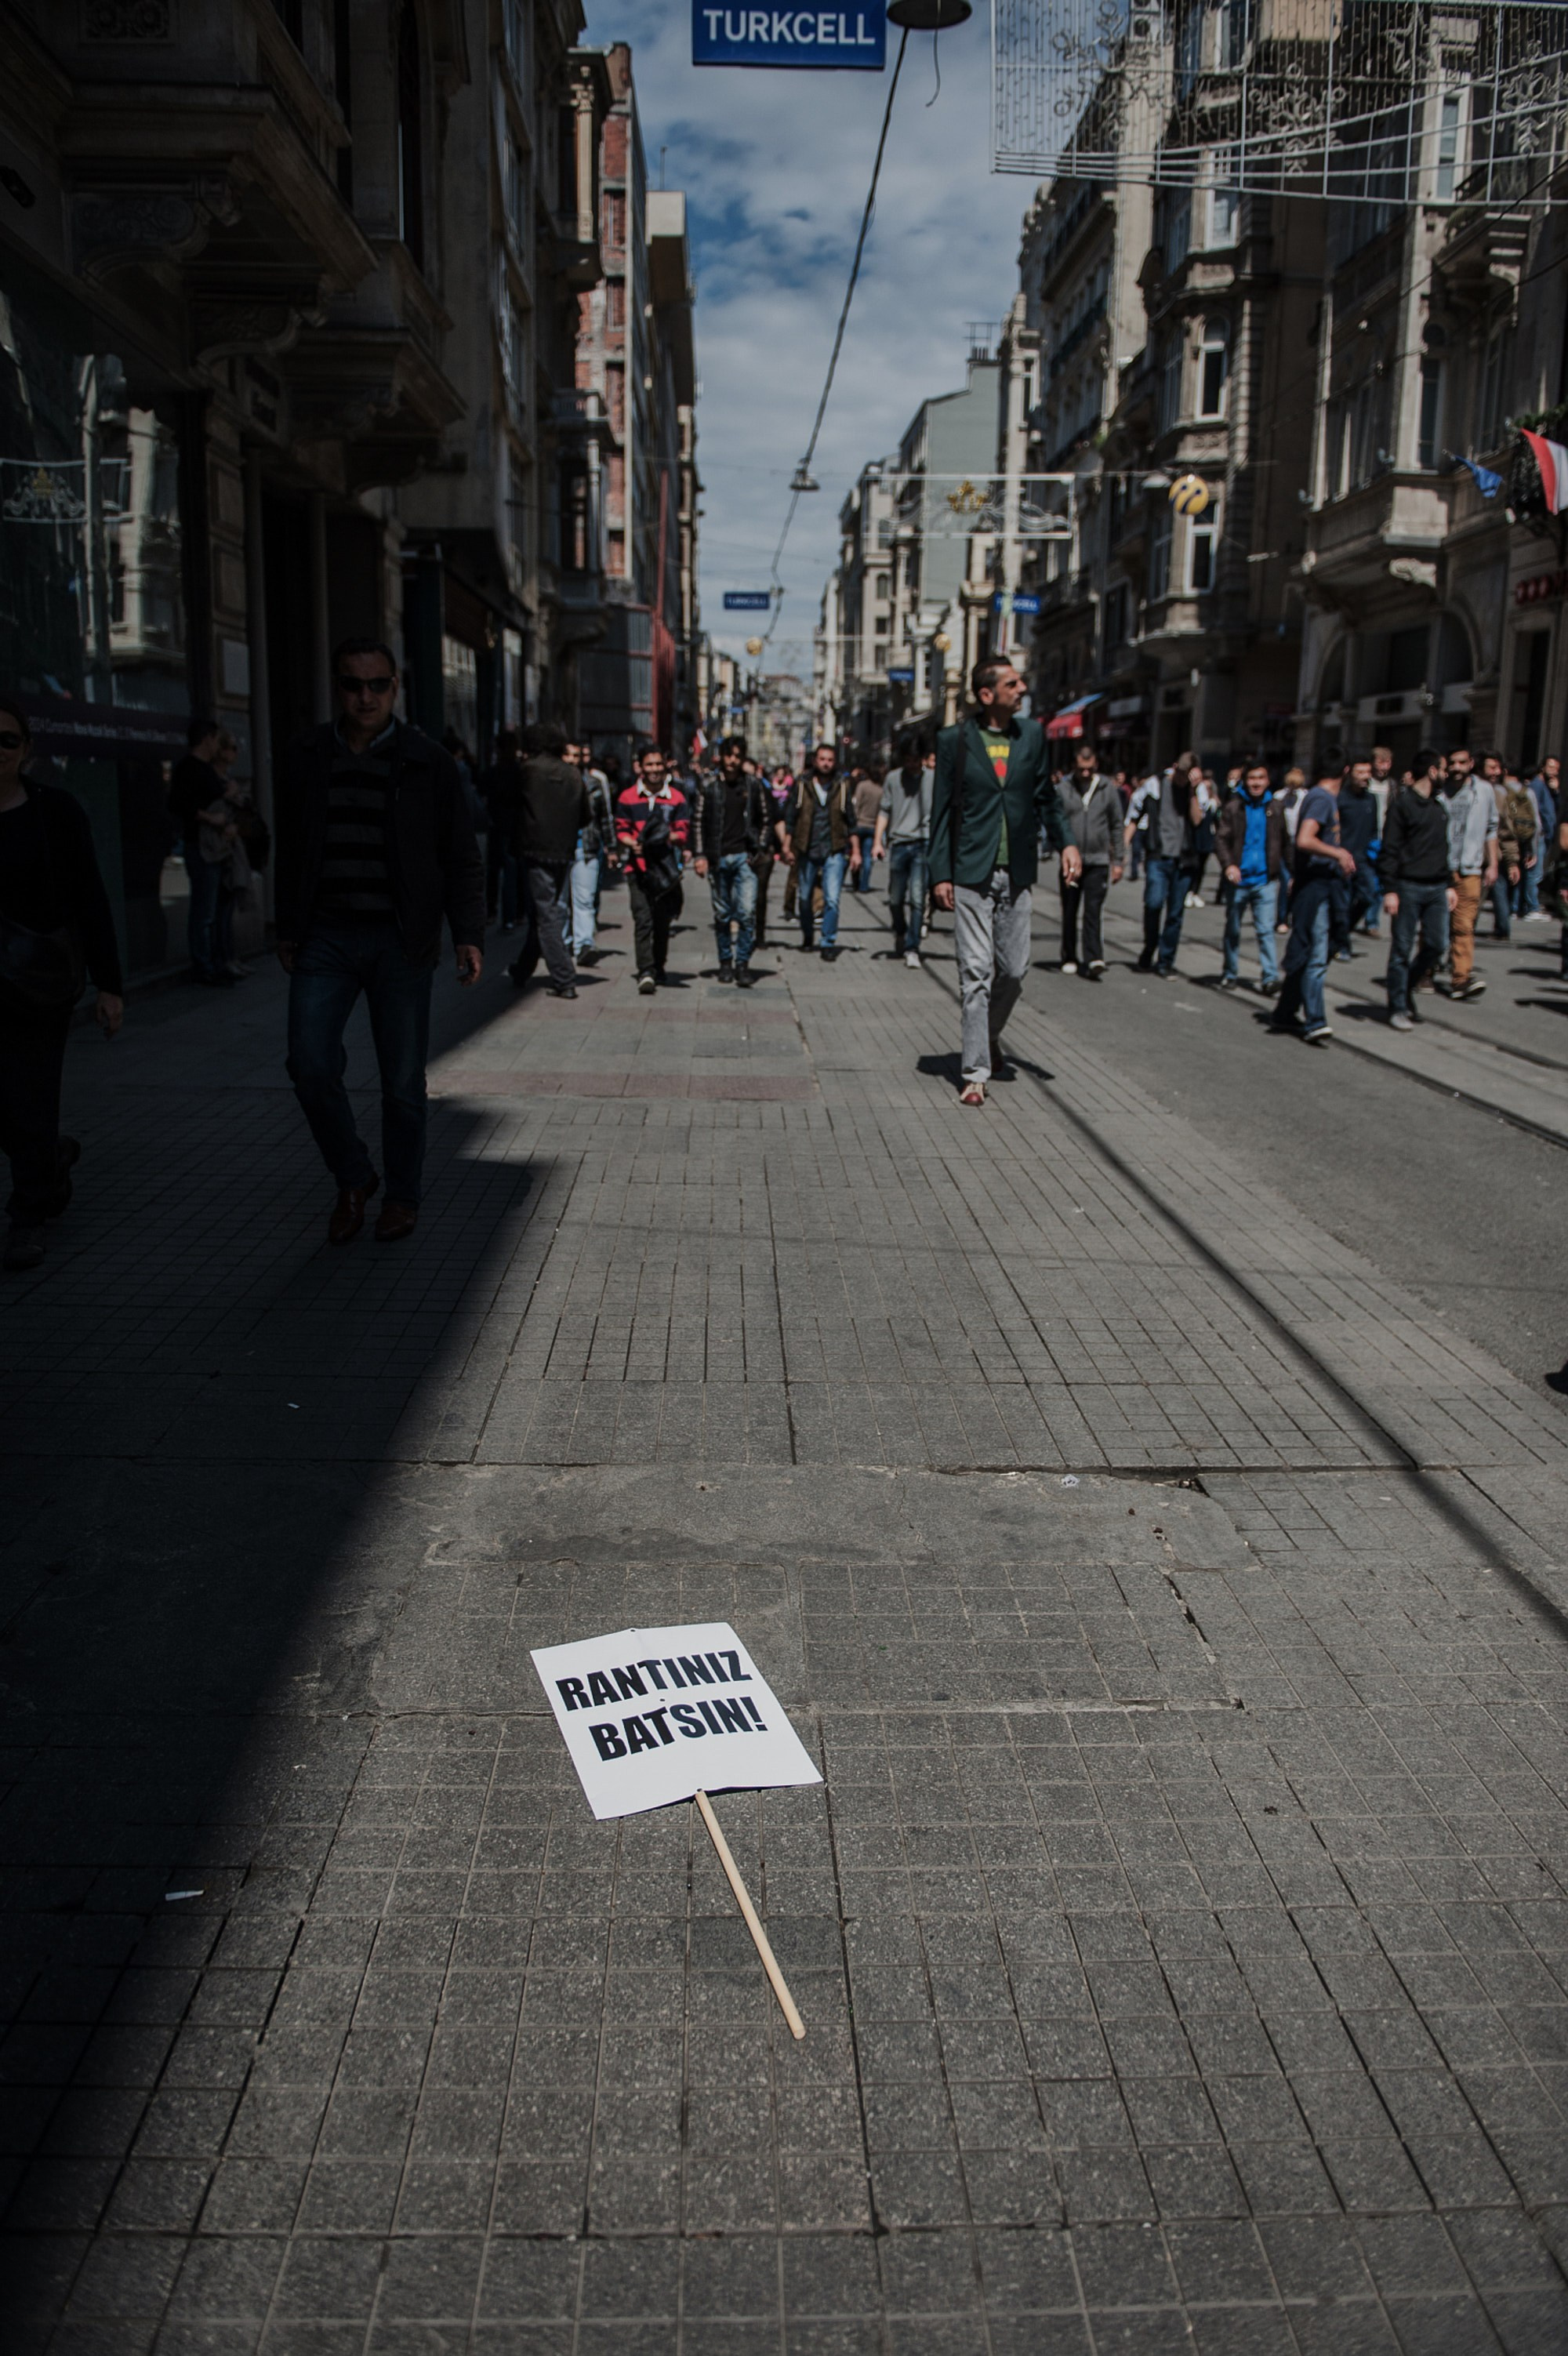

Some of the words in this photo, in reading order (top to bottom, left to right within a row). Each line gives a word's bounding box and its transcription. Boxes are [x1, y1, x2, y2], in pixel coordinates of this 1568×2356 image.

[703, 9, 876, 45] TURKCELL
[555, 1650, 753, 1712] RANTINIZ
[588, 1696, 768, 1762] BATSIN!
